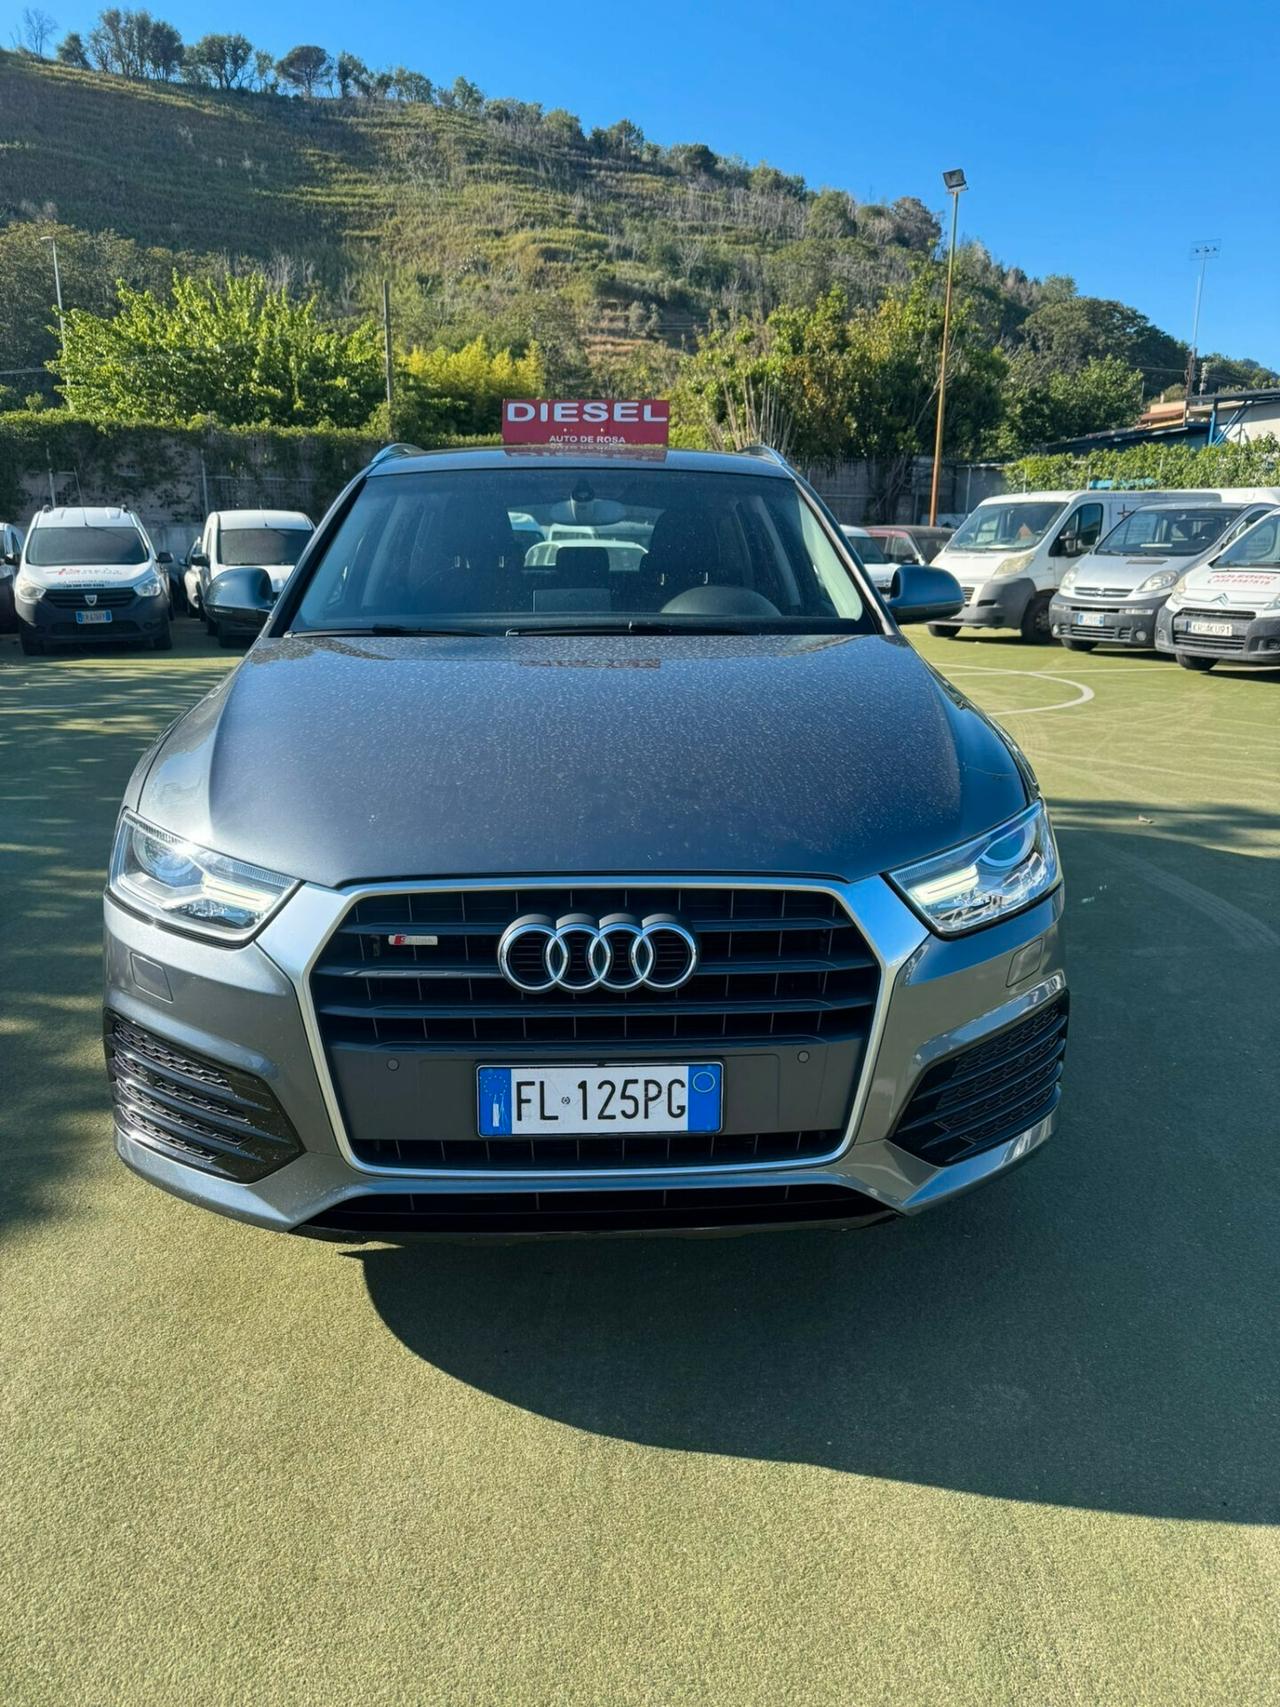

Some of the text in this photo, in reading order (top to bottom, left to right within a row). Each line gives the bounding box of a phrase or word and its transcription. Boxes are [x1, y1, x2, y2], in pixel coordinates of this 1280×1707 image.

[507, 402, 667, 422] DIESEL
[549, 435, 626, 444] AUTO DE ROSA
[516, 1079, 686, 1121] FL 125PG
